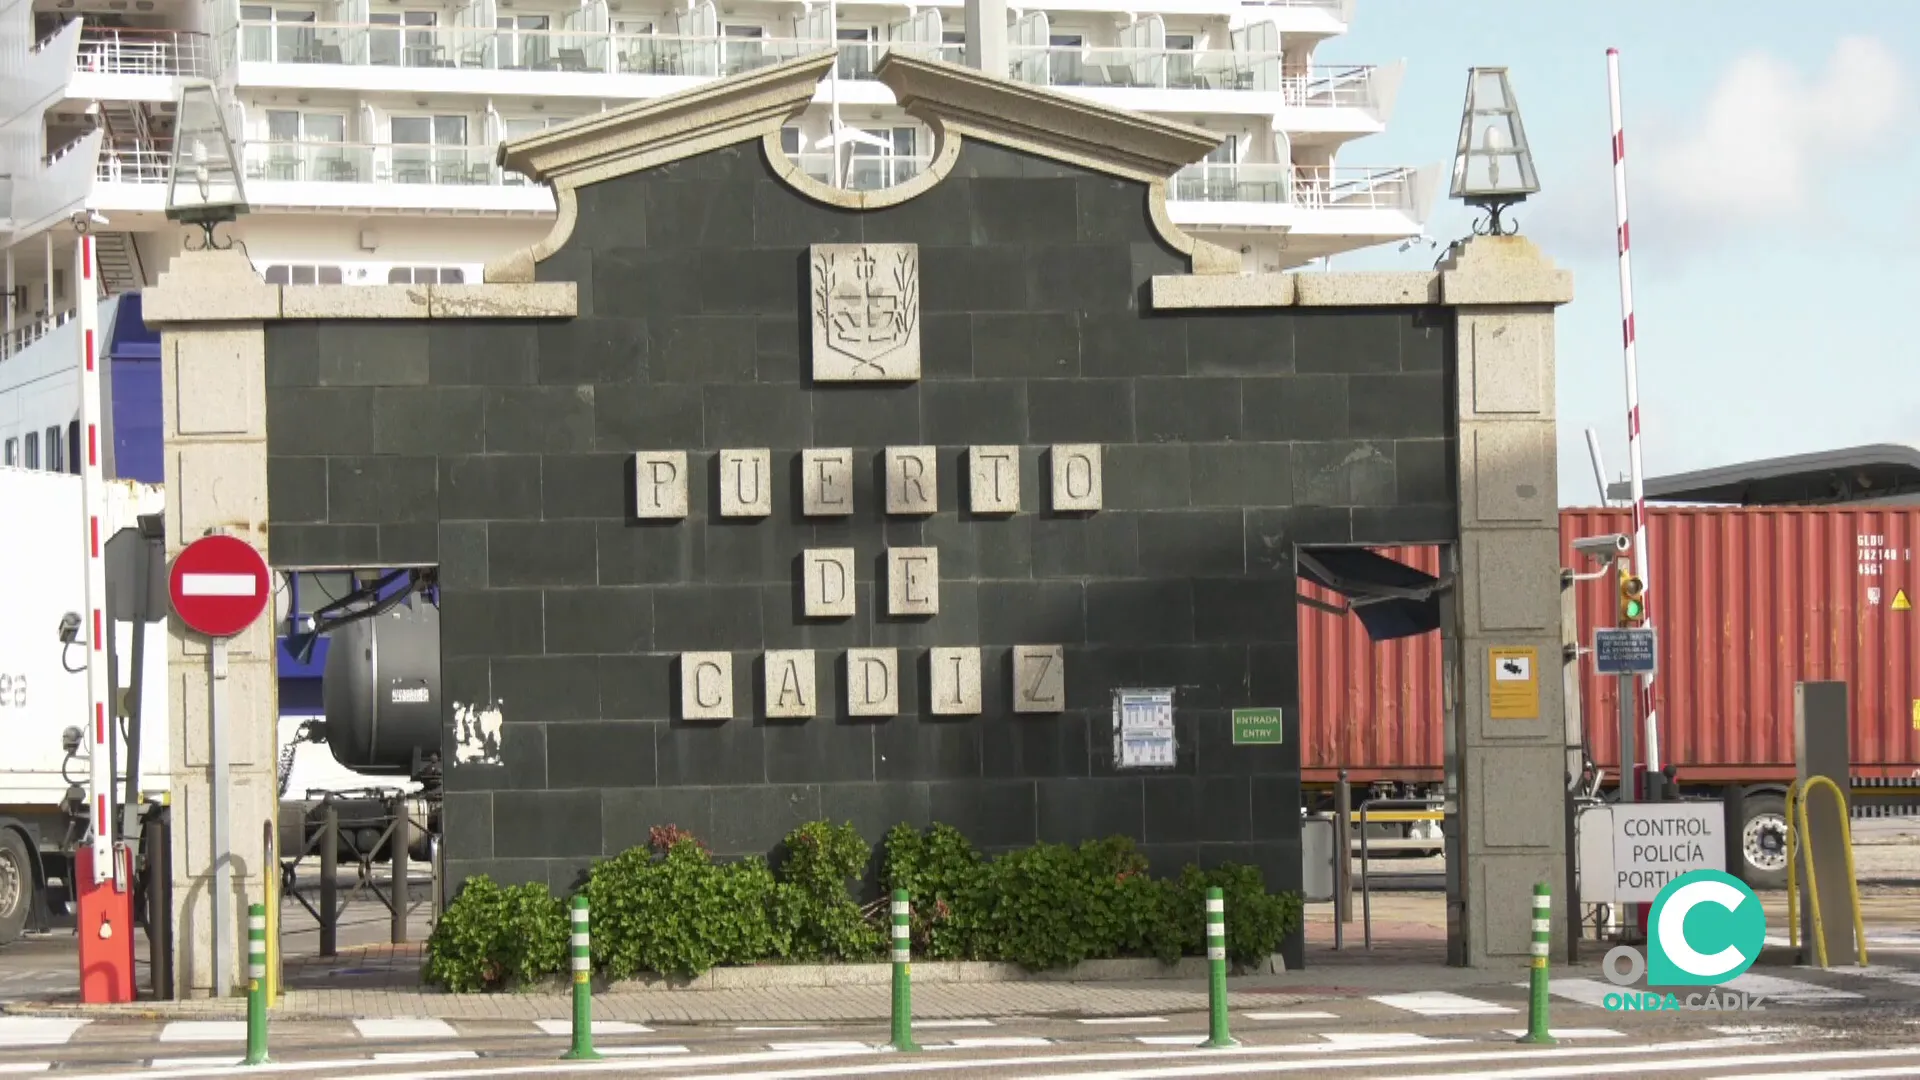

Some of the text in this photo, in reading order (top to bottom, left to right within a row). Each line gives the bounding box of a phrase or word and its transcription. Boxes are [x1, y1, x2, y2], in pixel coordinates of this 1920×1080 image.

[645, 453, 1094, 509] PUERTO
[813, 556, 929, 605] DE
[694, 654, 1056, 709] CADIZ
[1236, 716, 1279, 725] ENTRADA
[1242, 729, 1272, 738] ENTRY
[1623, 818, 1711, 837] CONTROL
[1633, 841, 1705, 863] POLICÍA
